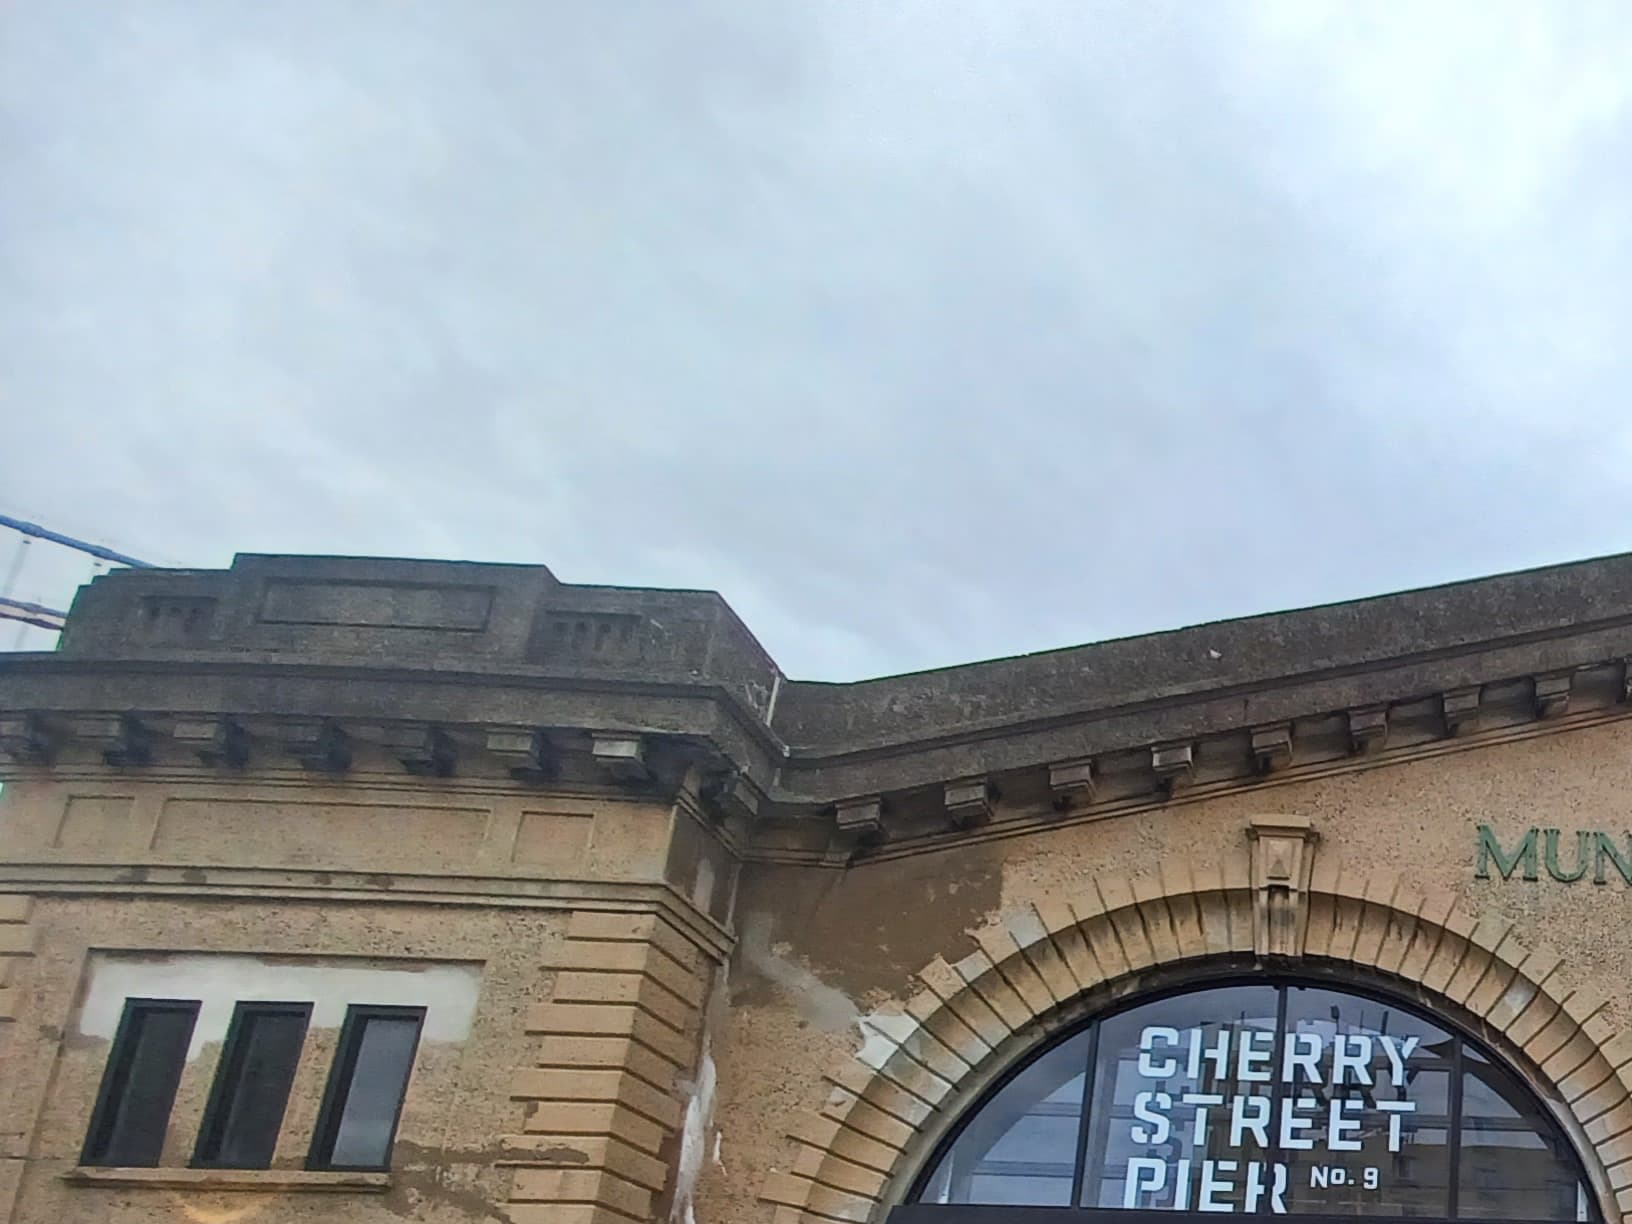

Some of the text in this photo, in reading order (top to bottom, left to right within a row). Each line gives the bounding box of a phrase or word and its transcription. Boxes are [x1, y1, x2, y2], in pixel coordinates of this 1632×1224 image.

[1138, 1026, 1419, 1087] CHERRY
[1130, 1091, 1416, 1152] STREET
[1123, 1157, 1288, 1214] PIER
[1362, 1167, 1379, 1190] 9
